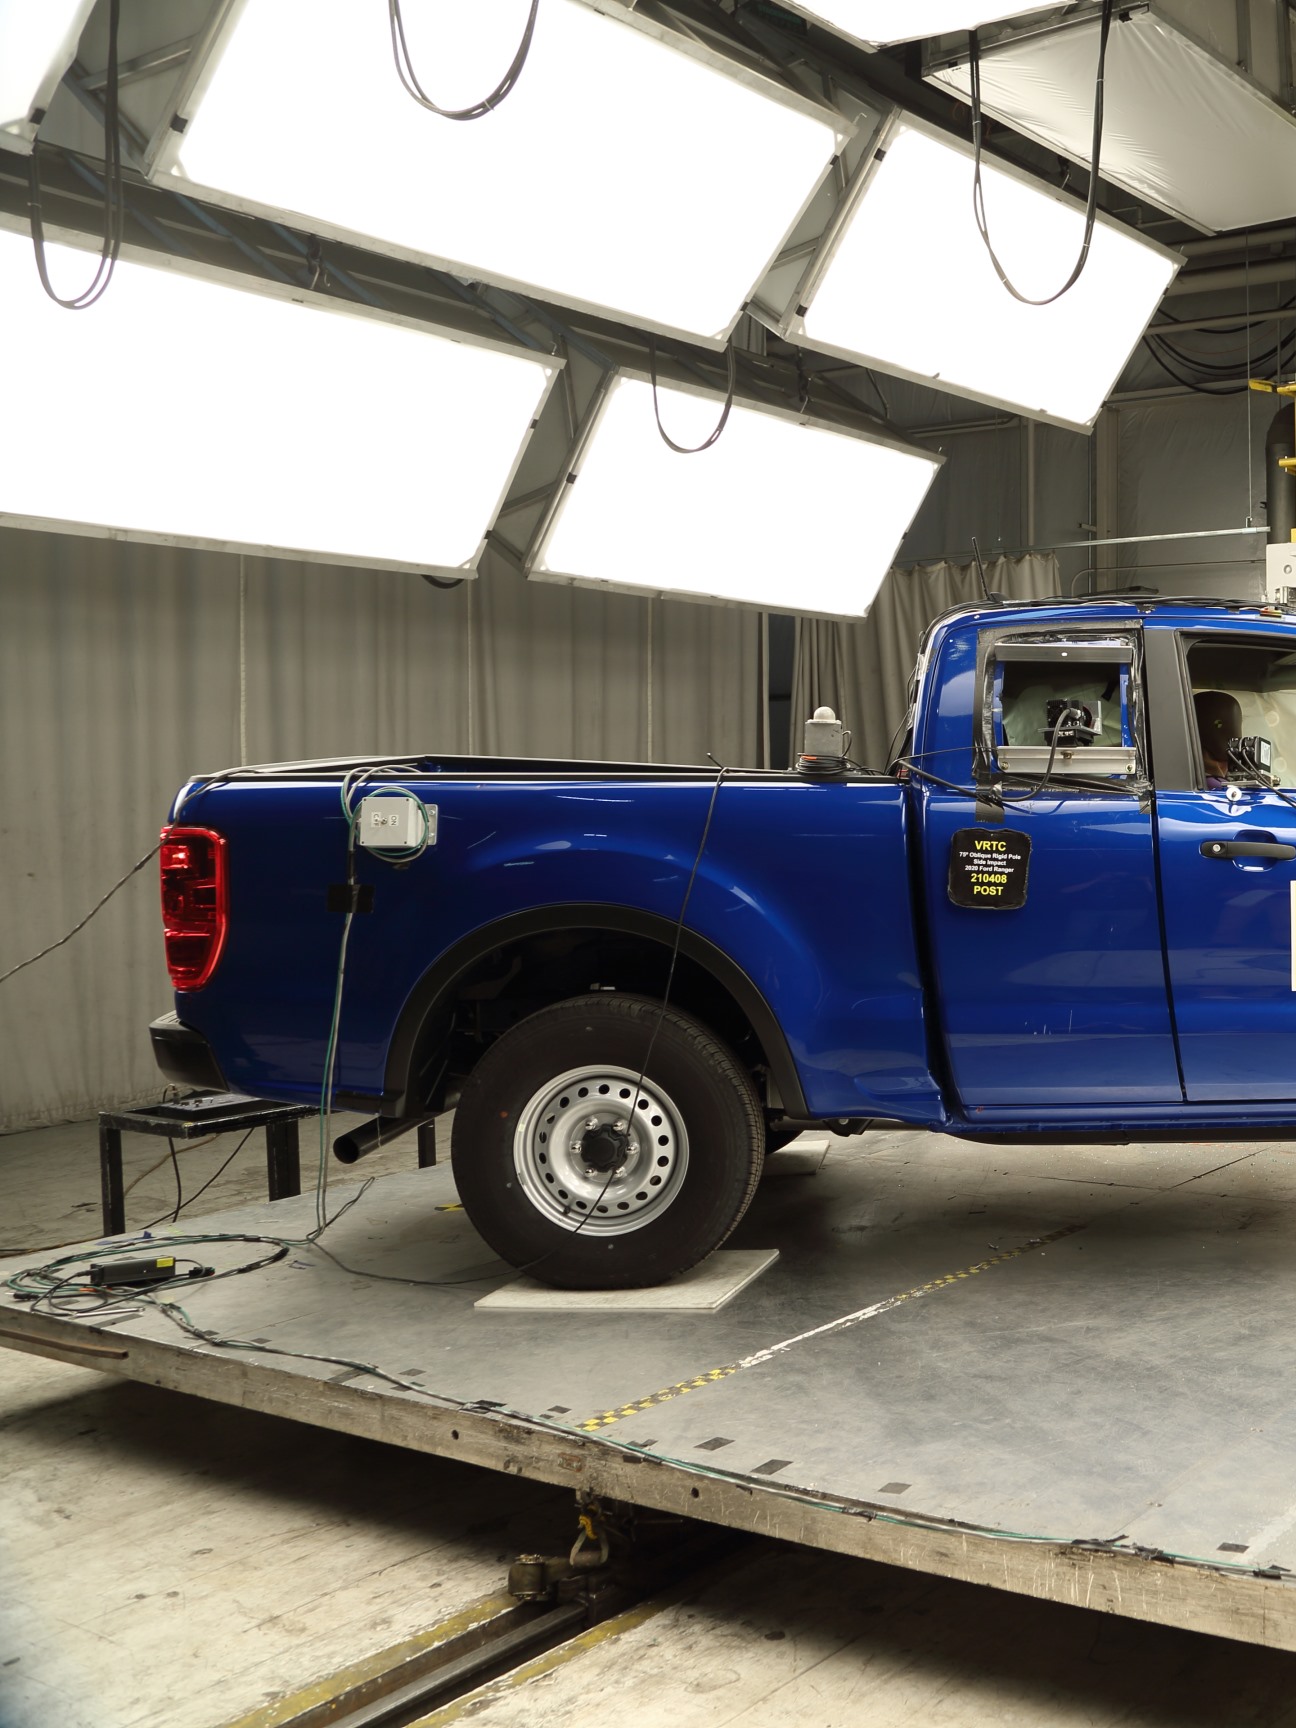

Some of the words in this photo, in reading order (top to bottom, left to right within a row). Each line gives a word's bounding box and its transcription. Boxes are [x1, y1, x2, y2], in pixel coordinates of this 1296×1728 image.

[391, 815, 397, 826] ON
[975, 841, 1006, 851] VRTC
[971, 873, 1007, 884] 210408
[973, 886, 1003, 896] POST
